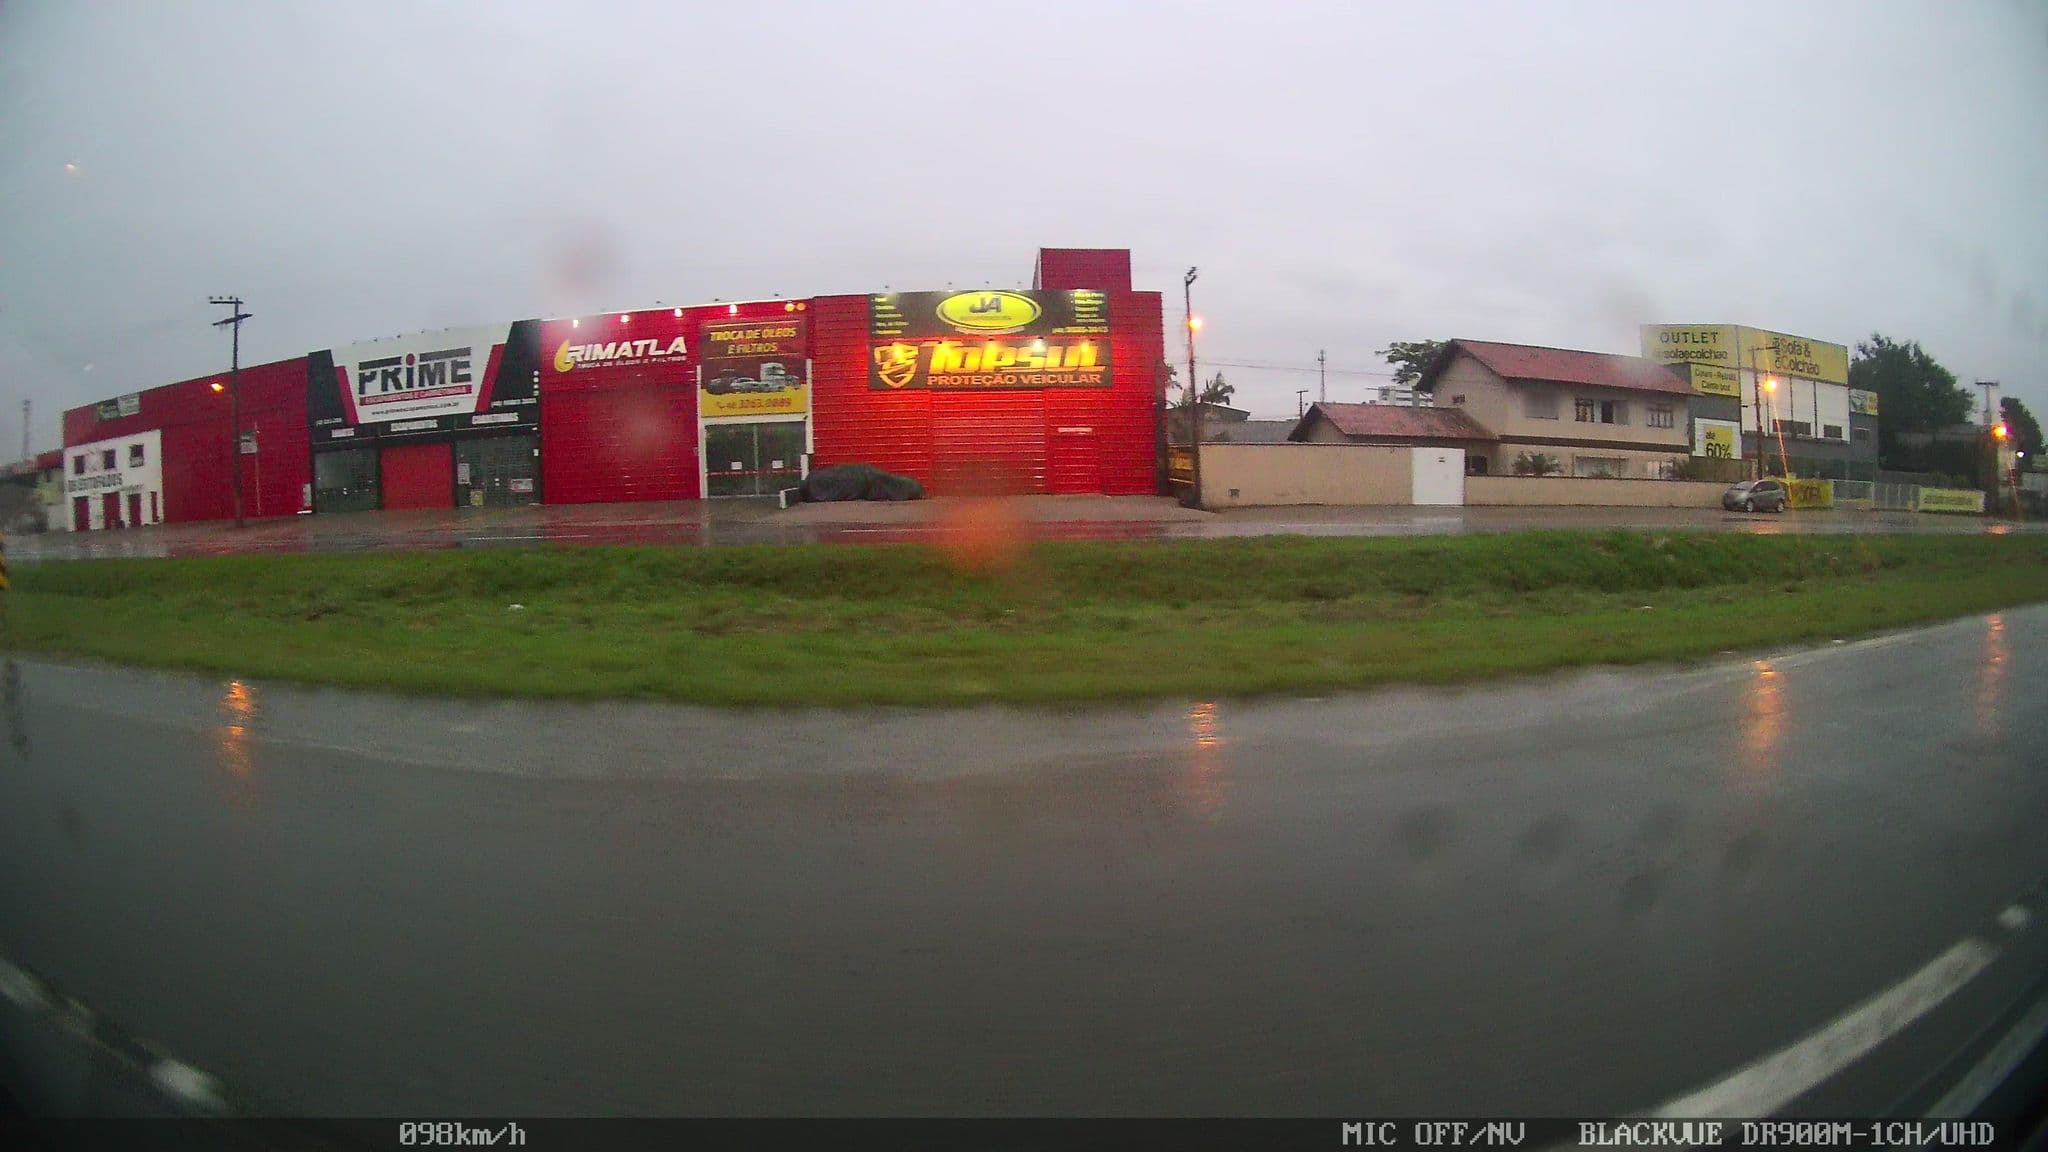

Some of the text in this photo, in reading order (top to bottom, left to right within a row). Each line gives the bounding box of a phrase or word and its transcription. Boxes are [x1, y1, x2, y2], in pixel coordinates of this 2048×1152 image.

[969, 295, 1001, 314] JA
[1660, 332, 1719, 344] OUTLET
[565, 336, 687, 362] RIMATLA
[927, 373, 1102, 387] PROTEÇÃO VEICULAR
[1706, 442, 1731, 459] 60%
